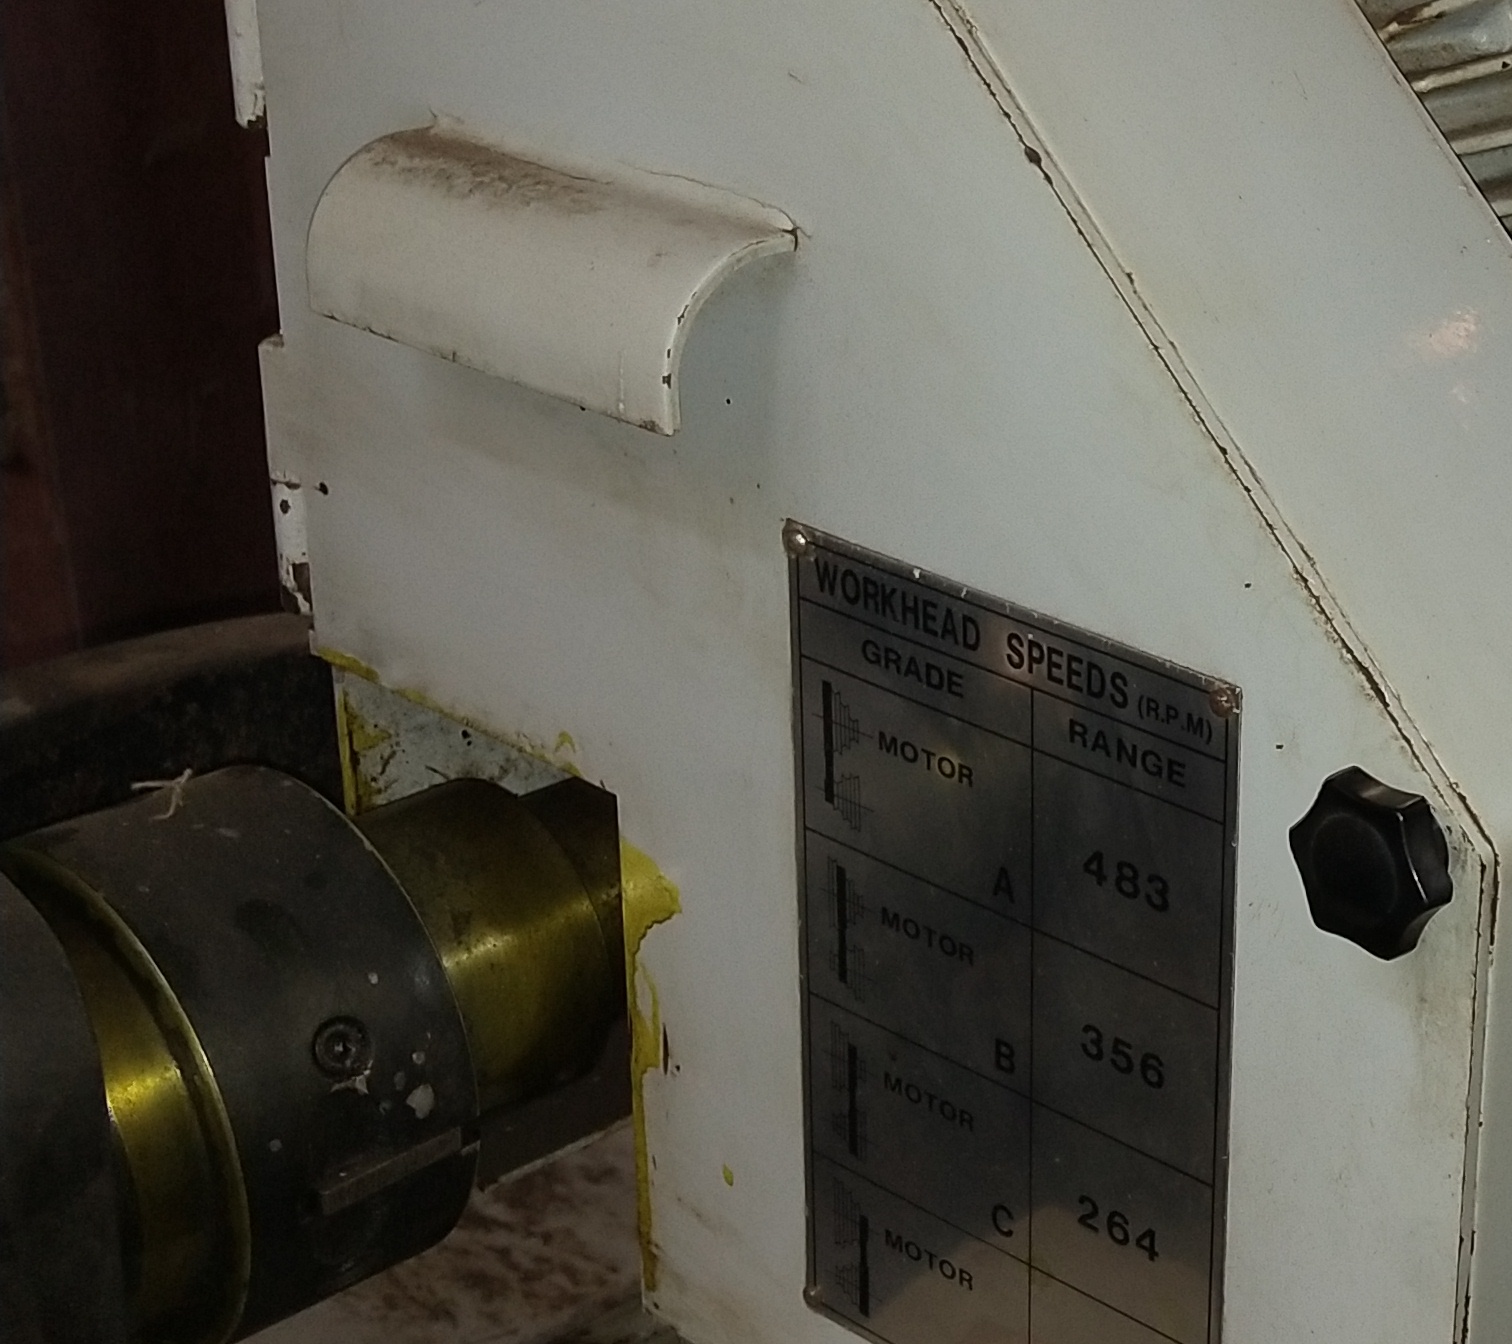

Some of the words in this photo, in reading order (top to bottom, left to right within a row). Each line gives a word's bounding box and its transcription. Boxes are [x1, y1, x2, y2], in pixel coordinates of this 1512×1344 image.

[814, 558, 982, 653] WORKHEAD
[1005, 631, 1130, 711] SPEEDS
[861, 637, 965, 699] GRADE
[878, 729, 976, 788] MOTOR
[1067, 717, 1187, 788] RANGE
[992, 865, 1016, 905] A
[1082, 849, 1172, 914] 483
[880, 905, 976, 968] MOTOR
[994, 1038, 1017, 1076] B
[1080, 1023, 1166, 1091] 356
[883, 1071, 975, 1132] MOTOR
[991, 1203, 1015, 1239] C
[1077, 1195, 1160, 1262] 264
[884, 1228, 974, 1291] MOTOR
